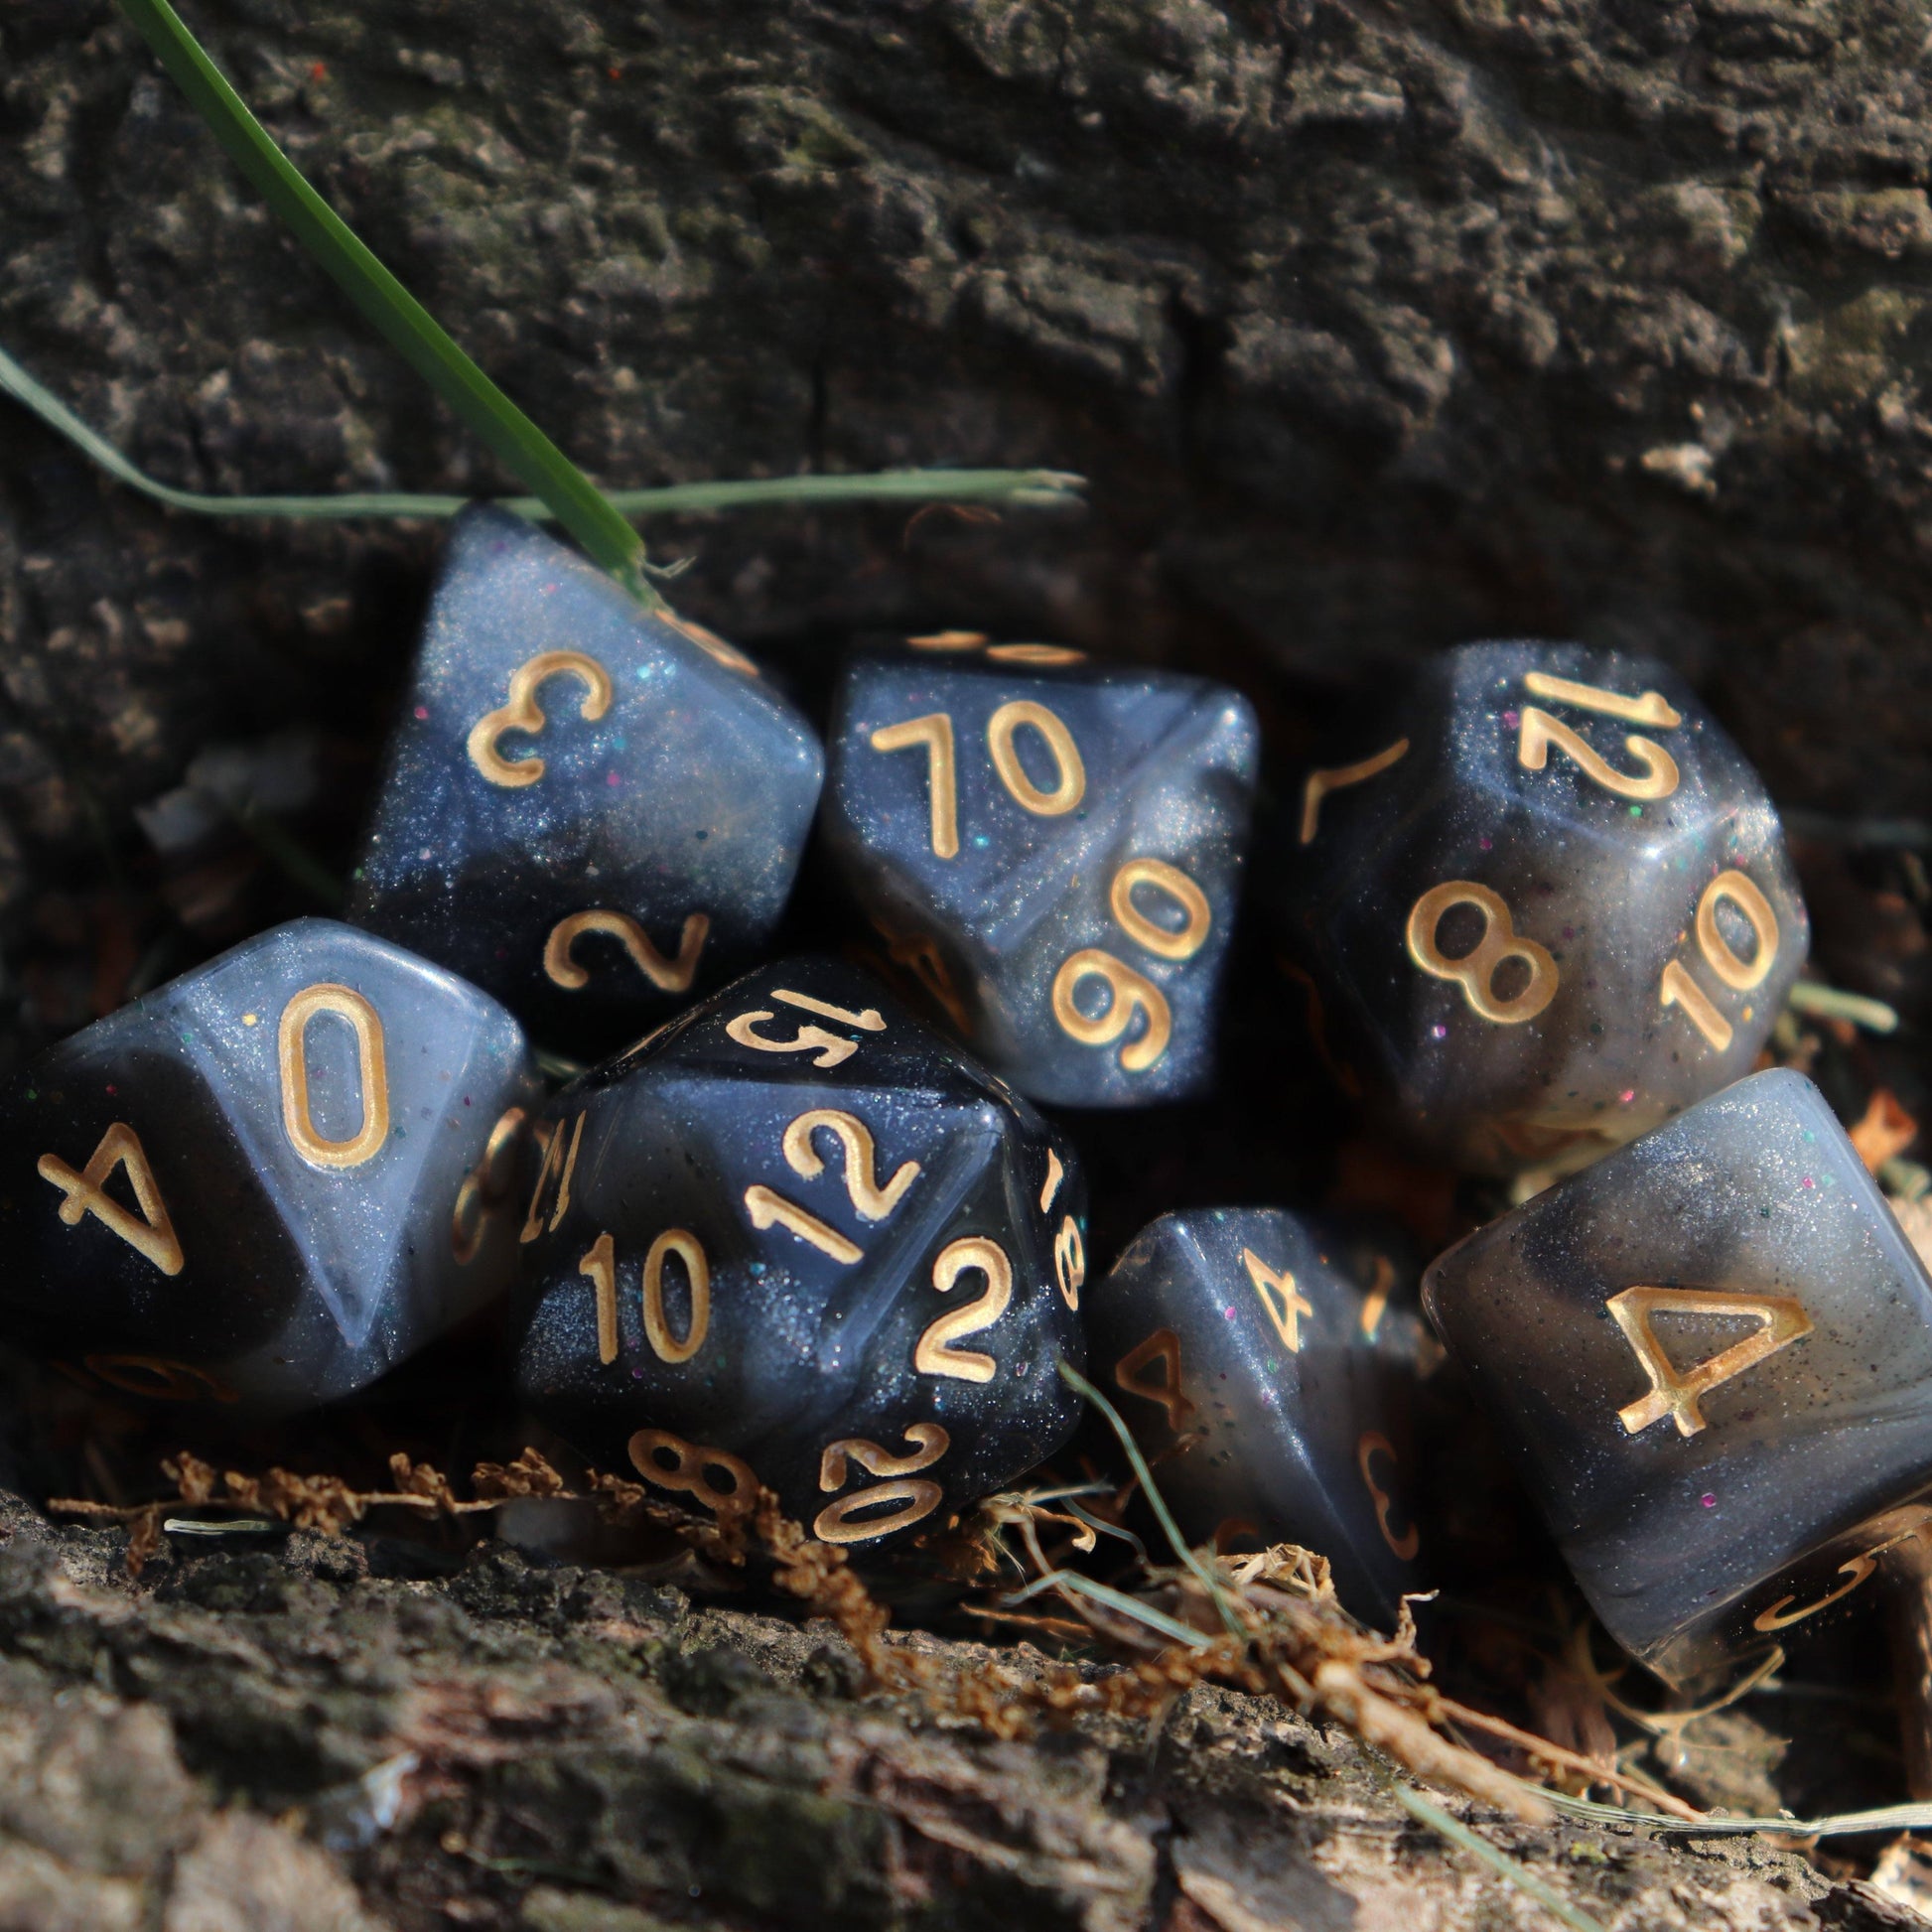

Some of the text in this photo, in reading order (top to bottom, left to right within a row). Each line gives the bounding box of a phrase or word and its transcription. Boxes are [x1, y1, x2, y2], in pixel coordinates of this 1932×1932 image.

[468, 650, 613, 787] 3
[871, 700, 1086, 860] 70
[1519, 671, 1682, 801] 12
[544, 909, 709, 992] 2
[1052, 858, 1211, 1072] 90
[1406, 880, 1560, 1025] 8
[1661, 869, 1779, 1052] 10
[278, 983, 388, 1168] 0
[726, 989, 887, 1068] 15
[37, 1122, 185, 1276] 4
[744, 1108, 922, 1265] 12
[579, 1228, 710, 1365] 10
[915, 1236, 1014, 1384] 2
[1243, 1248, 1312, 1354] 4
[1604, 1285, 1817, 1439] 4
[1115, 1327, 1196, 1433] 4
[627, 1428, 761, 1519] 8
[814, 1423, 951, 1544] 20
